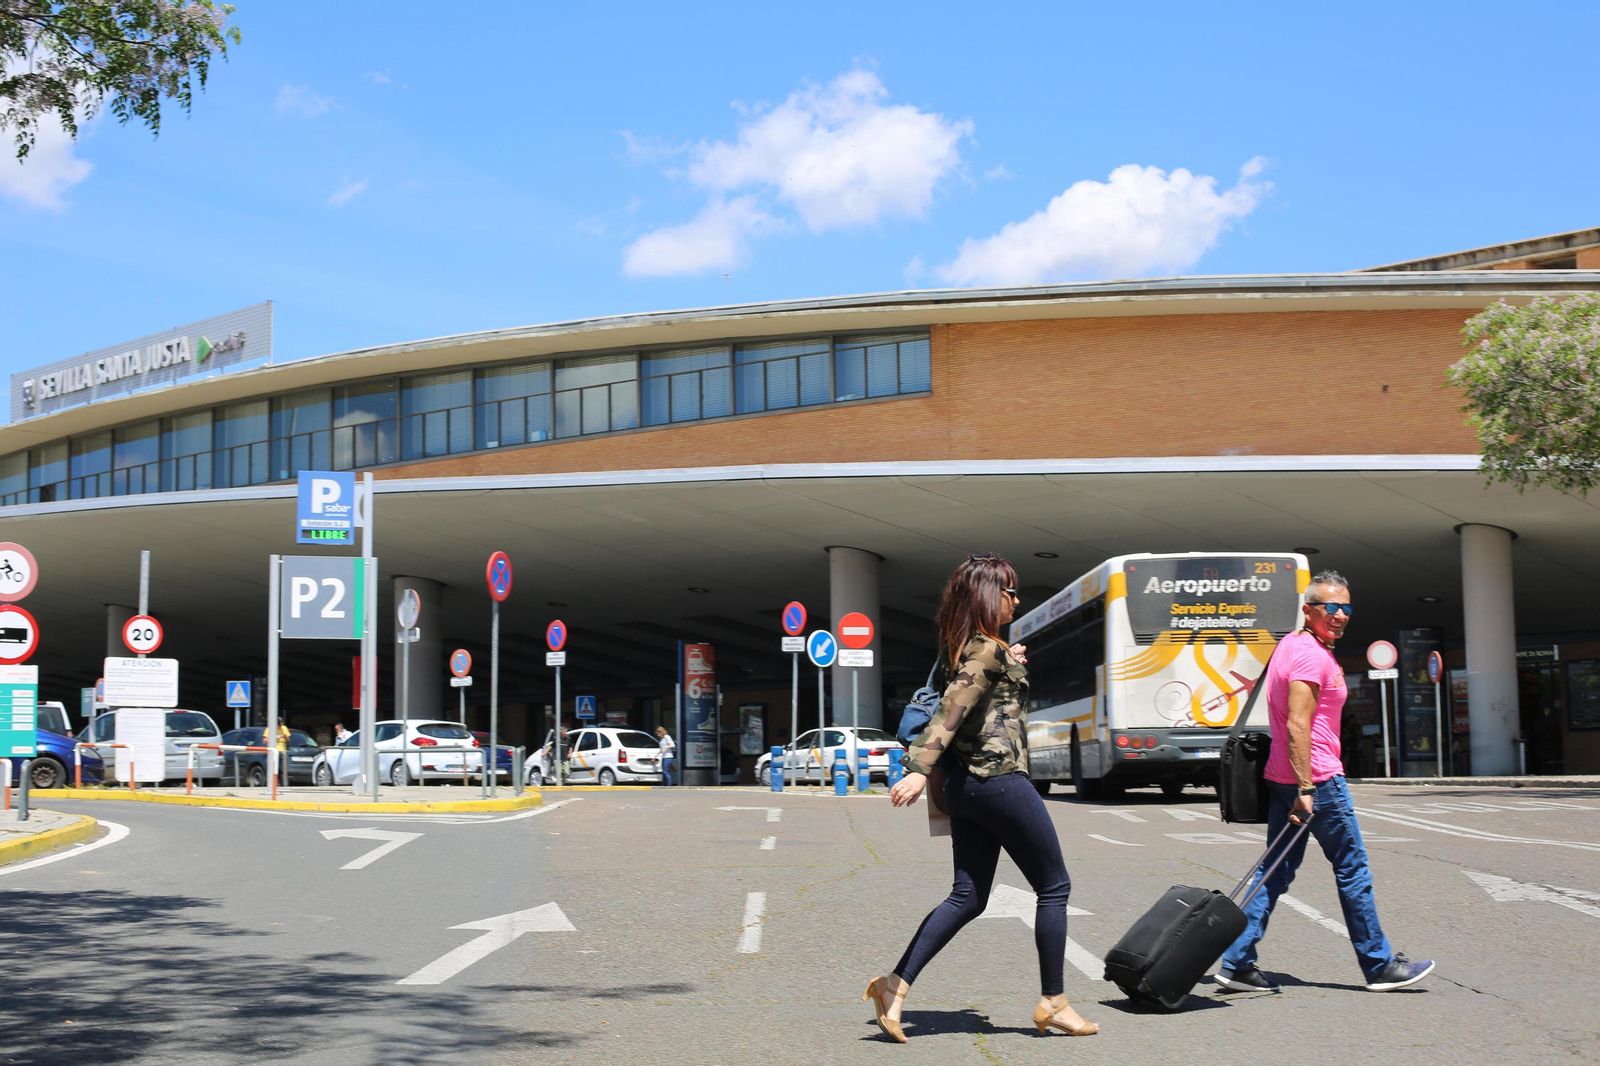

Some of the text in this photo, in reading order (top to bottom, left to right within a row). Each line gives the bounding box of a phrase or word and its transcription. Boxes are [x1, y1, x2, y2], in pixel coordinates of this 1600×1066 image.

[38, 335, 192, 400] SEVILLA SANTA JUSTA
[311, 478, 342, 514] P
[311, 530, 347, 540] LIBRE
[1254, 562, 1277, 574] 231
[1143, 575, 1271, 597] Aeropuerto
[290, 576, 346, 619] P2
[1169, 602, 1217, 615] Servicio
[1169, 616, 1258, 631] #dejatellevar
[132, 628, 154, 641] 20
[688, 678, 702, 699] 6
